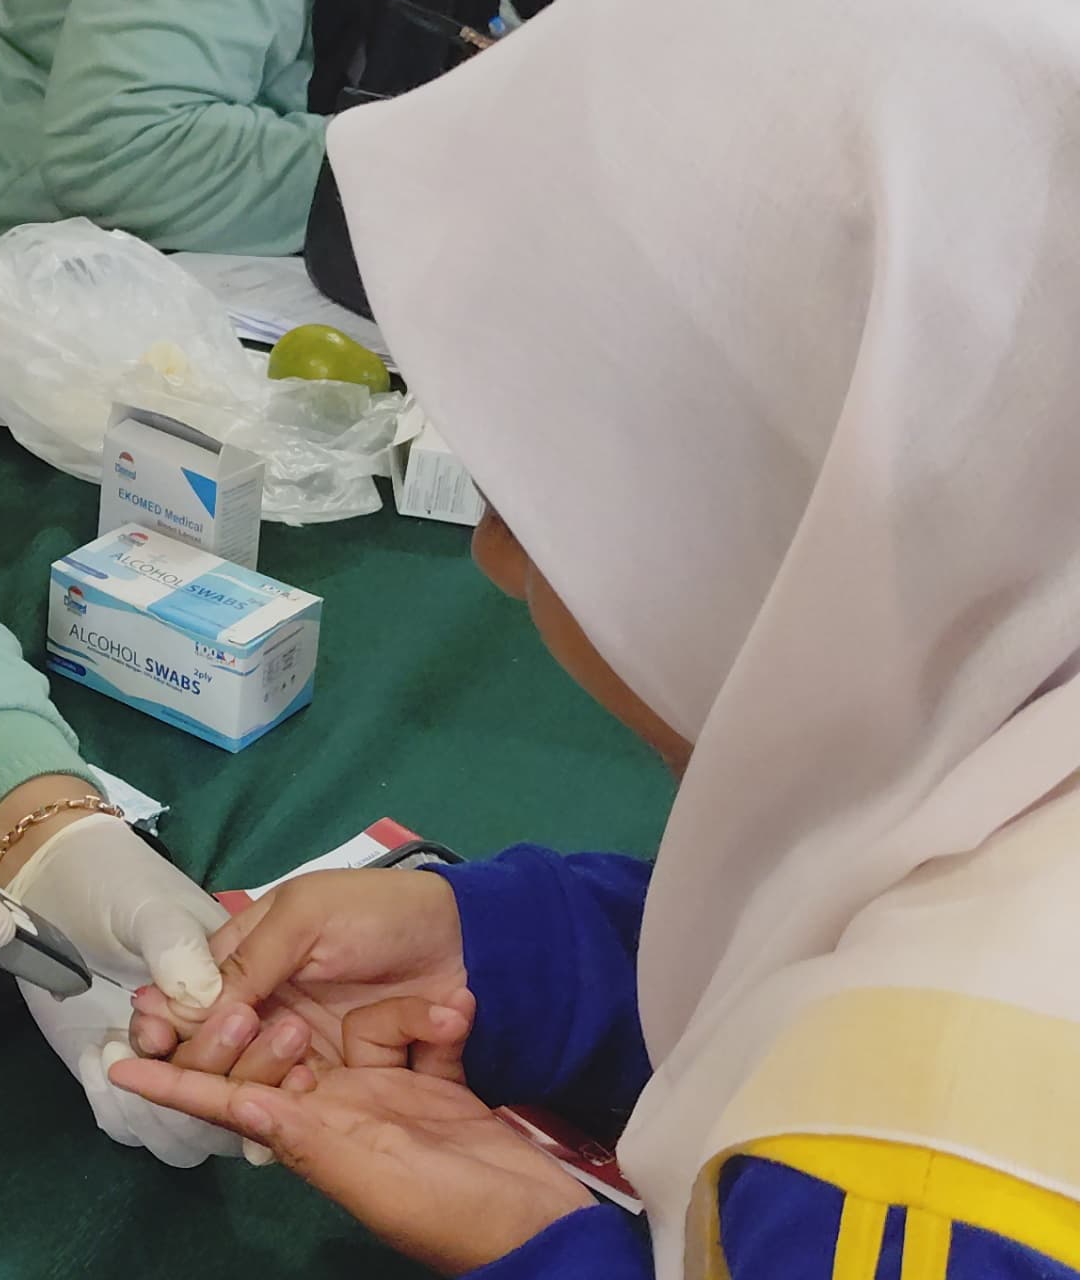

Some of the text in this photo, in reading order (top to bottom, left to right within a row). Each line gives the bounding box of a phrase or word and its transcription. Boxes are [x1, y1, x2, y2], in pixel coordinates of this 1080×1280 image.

[164, 507, 204, 533] Medical
[110, 552, 184, 587] ALCOHOL
[186, 583, 249, 612] SWABS
[69, 623, 141, 668] ALCOHOL
[144, 657, 201, 696] SWABS
[193, 669, 214, 684] 2ply
